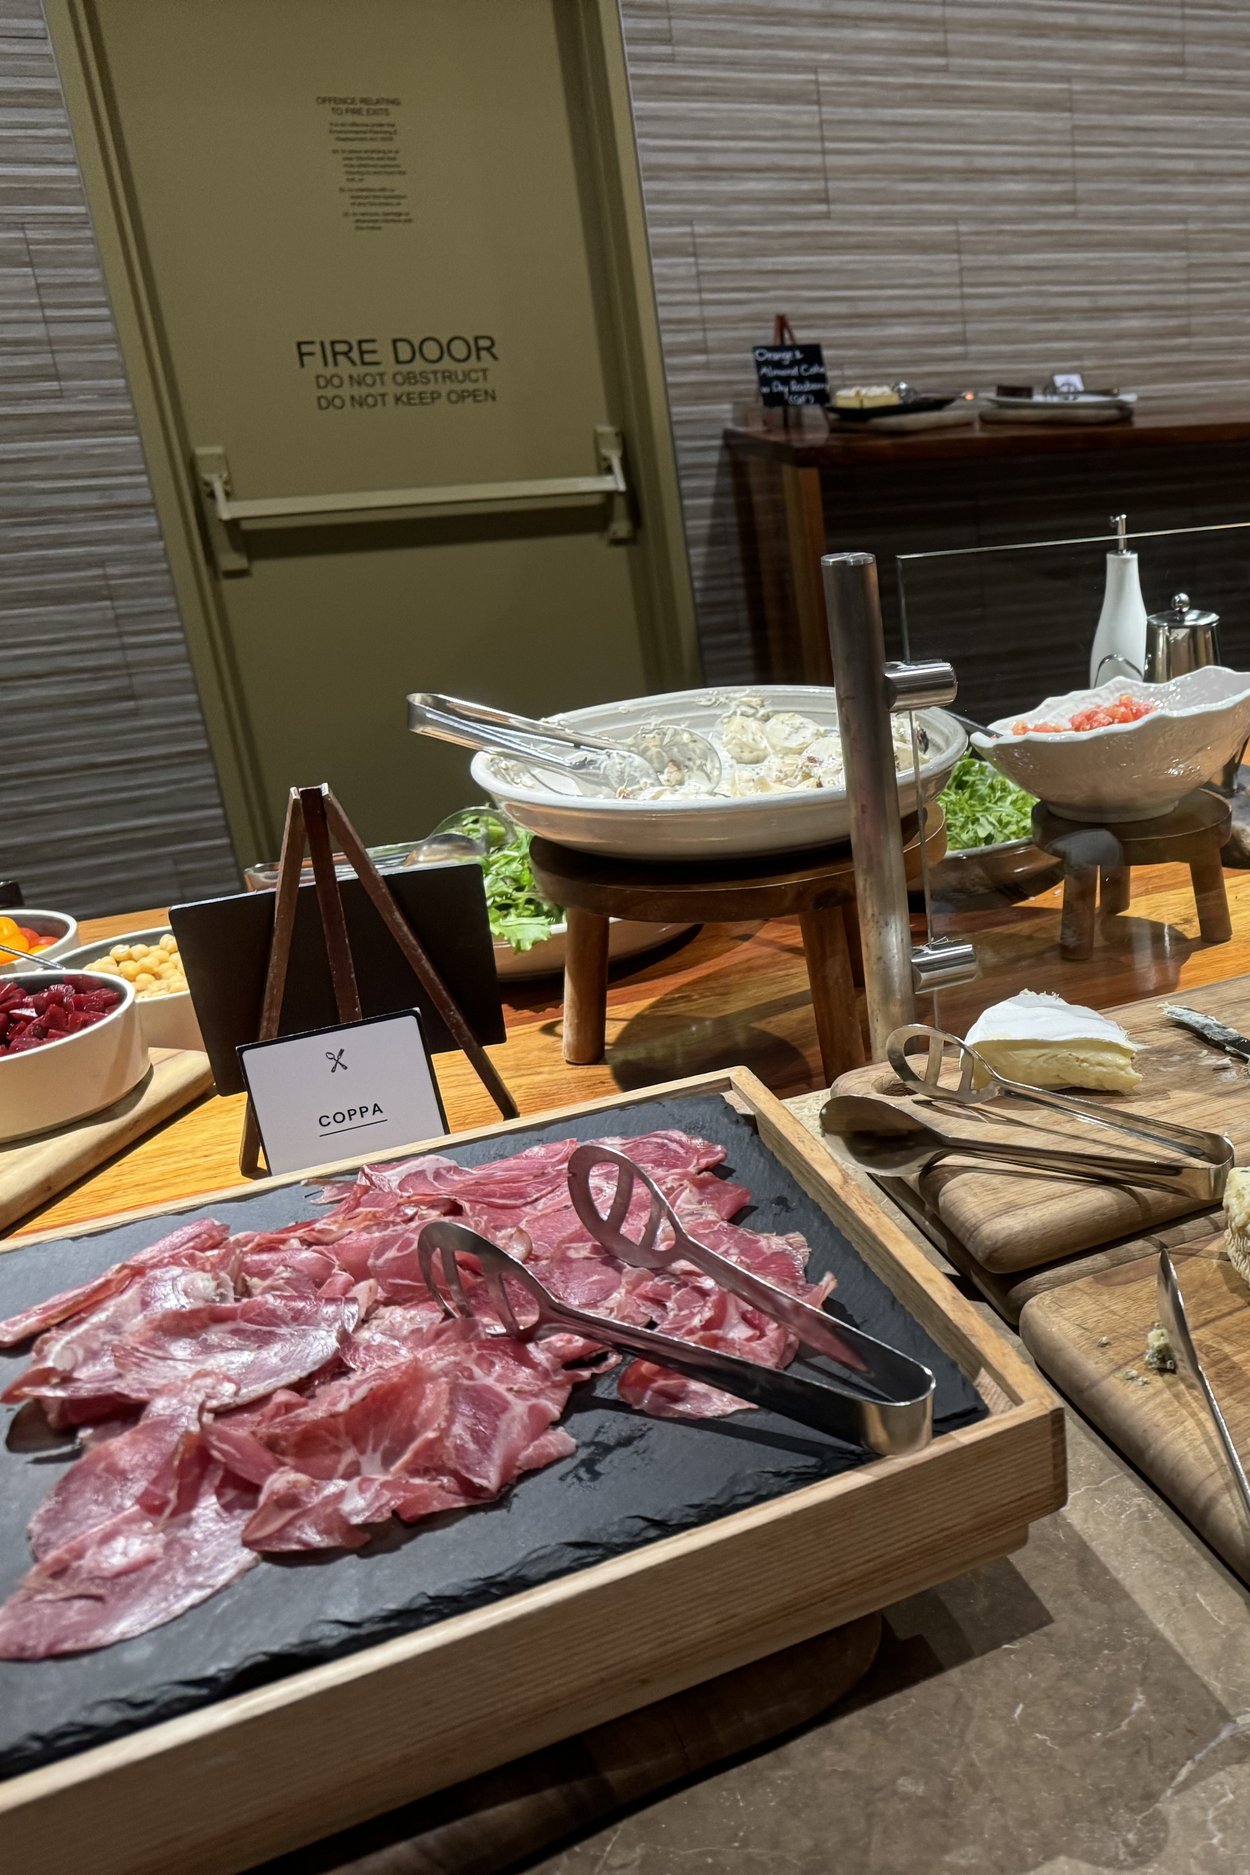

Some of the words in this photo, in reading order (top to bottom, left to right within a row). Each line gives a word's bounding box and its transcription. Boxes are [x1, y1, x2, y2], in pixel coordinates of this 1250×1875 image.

[296, 338, 382, 368] FIRE
[392, 335, 499, 364] DOOR
[315, 374, 344, 389] DO
[349, 371, 387, 388] NOT
[392, 368, 489, 386] OBSTRUCT
[760, 365, 799, 377] Almond
[317, 395, 346, 410] DO
[351, 393, 389, 408] NOT
[394, 390, 441, 406] KEEP
[446, 388, 497, 405] OPEN
[318, 1103, 384, 1127] COPPA
